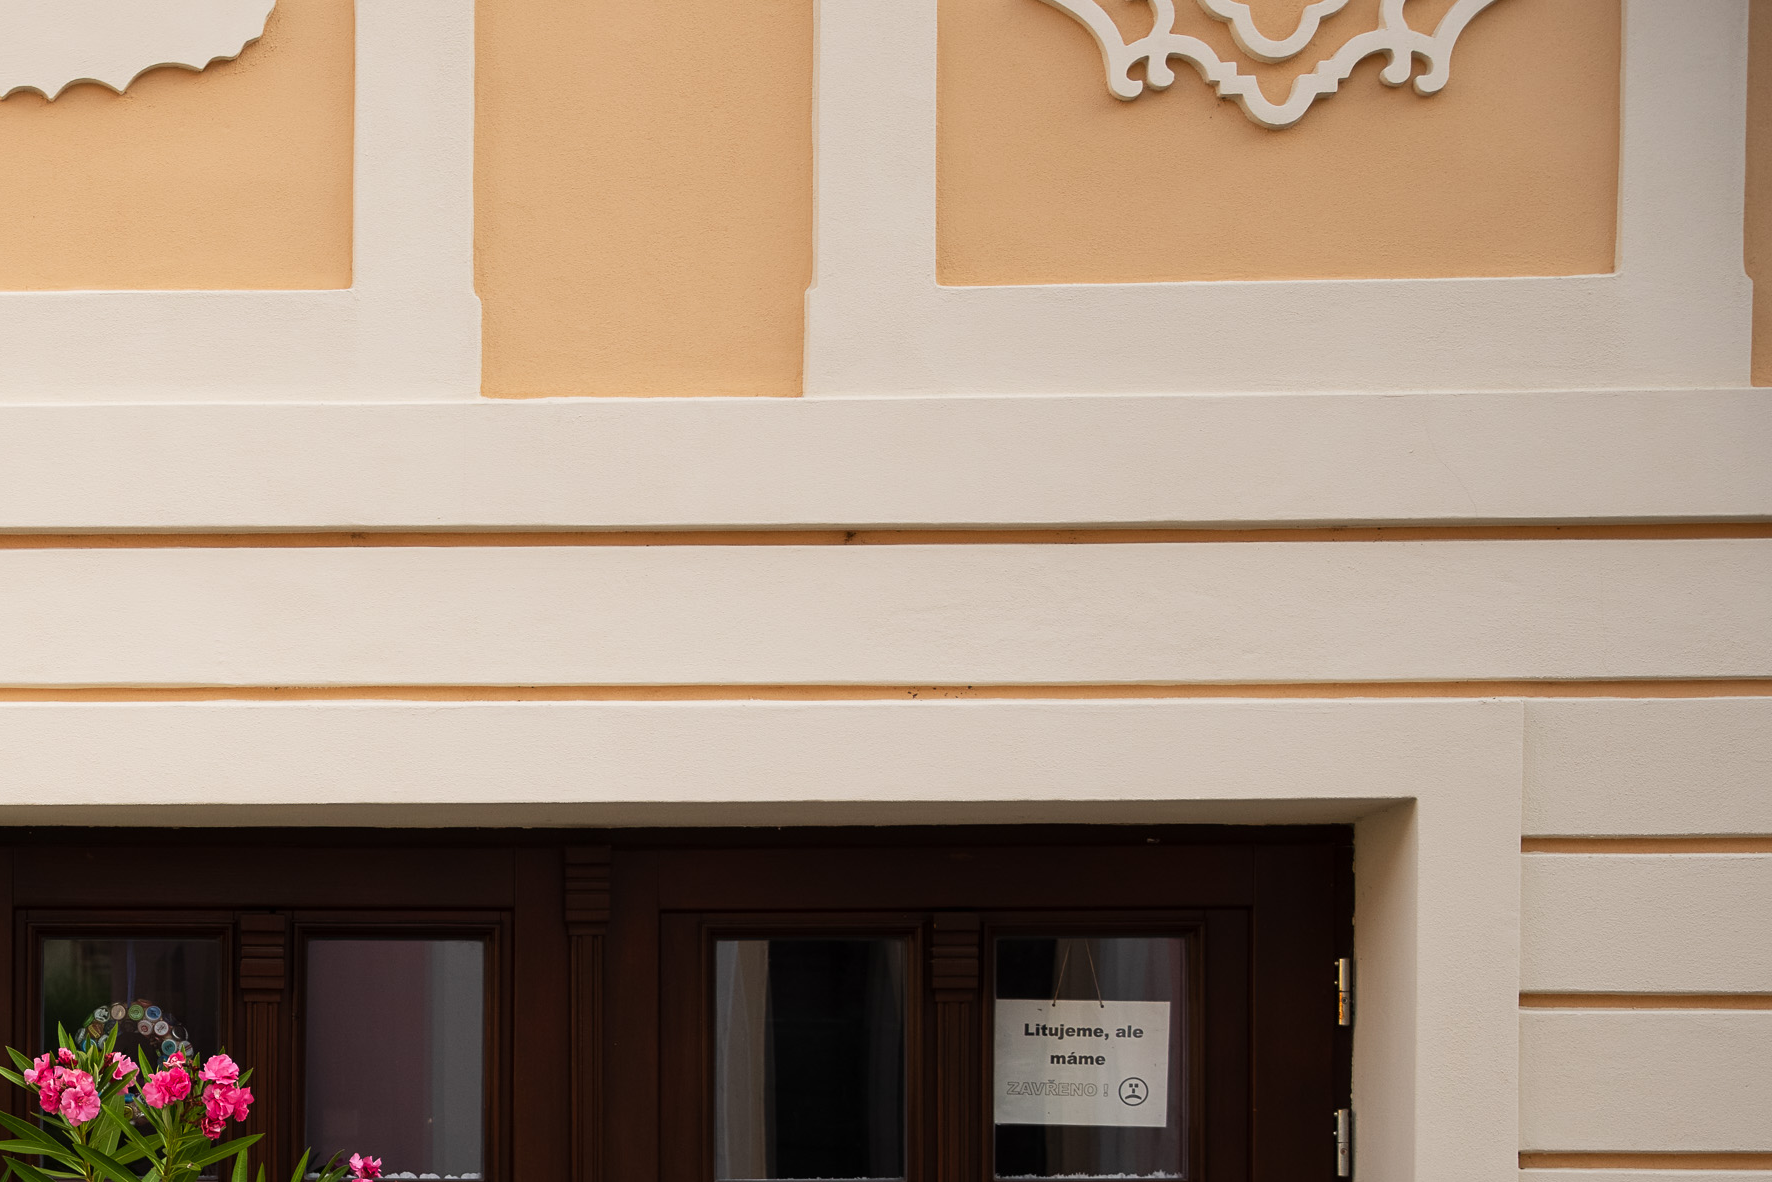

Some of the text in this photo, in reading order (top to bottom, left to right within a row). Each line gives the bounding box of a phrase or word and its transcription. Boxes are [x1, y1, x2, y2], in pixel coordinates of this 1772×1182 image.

[1024, 1023, 1144, 1040] Litujeme, ale
[1050, 1052, 1106, 1065] máme
[1006, 1079, 1109, 1097] ZAVŘENO !
